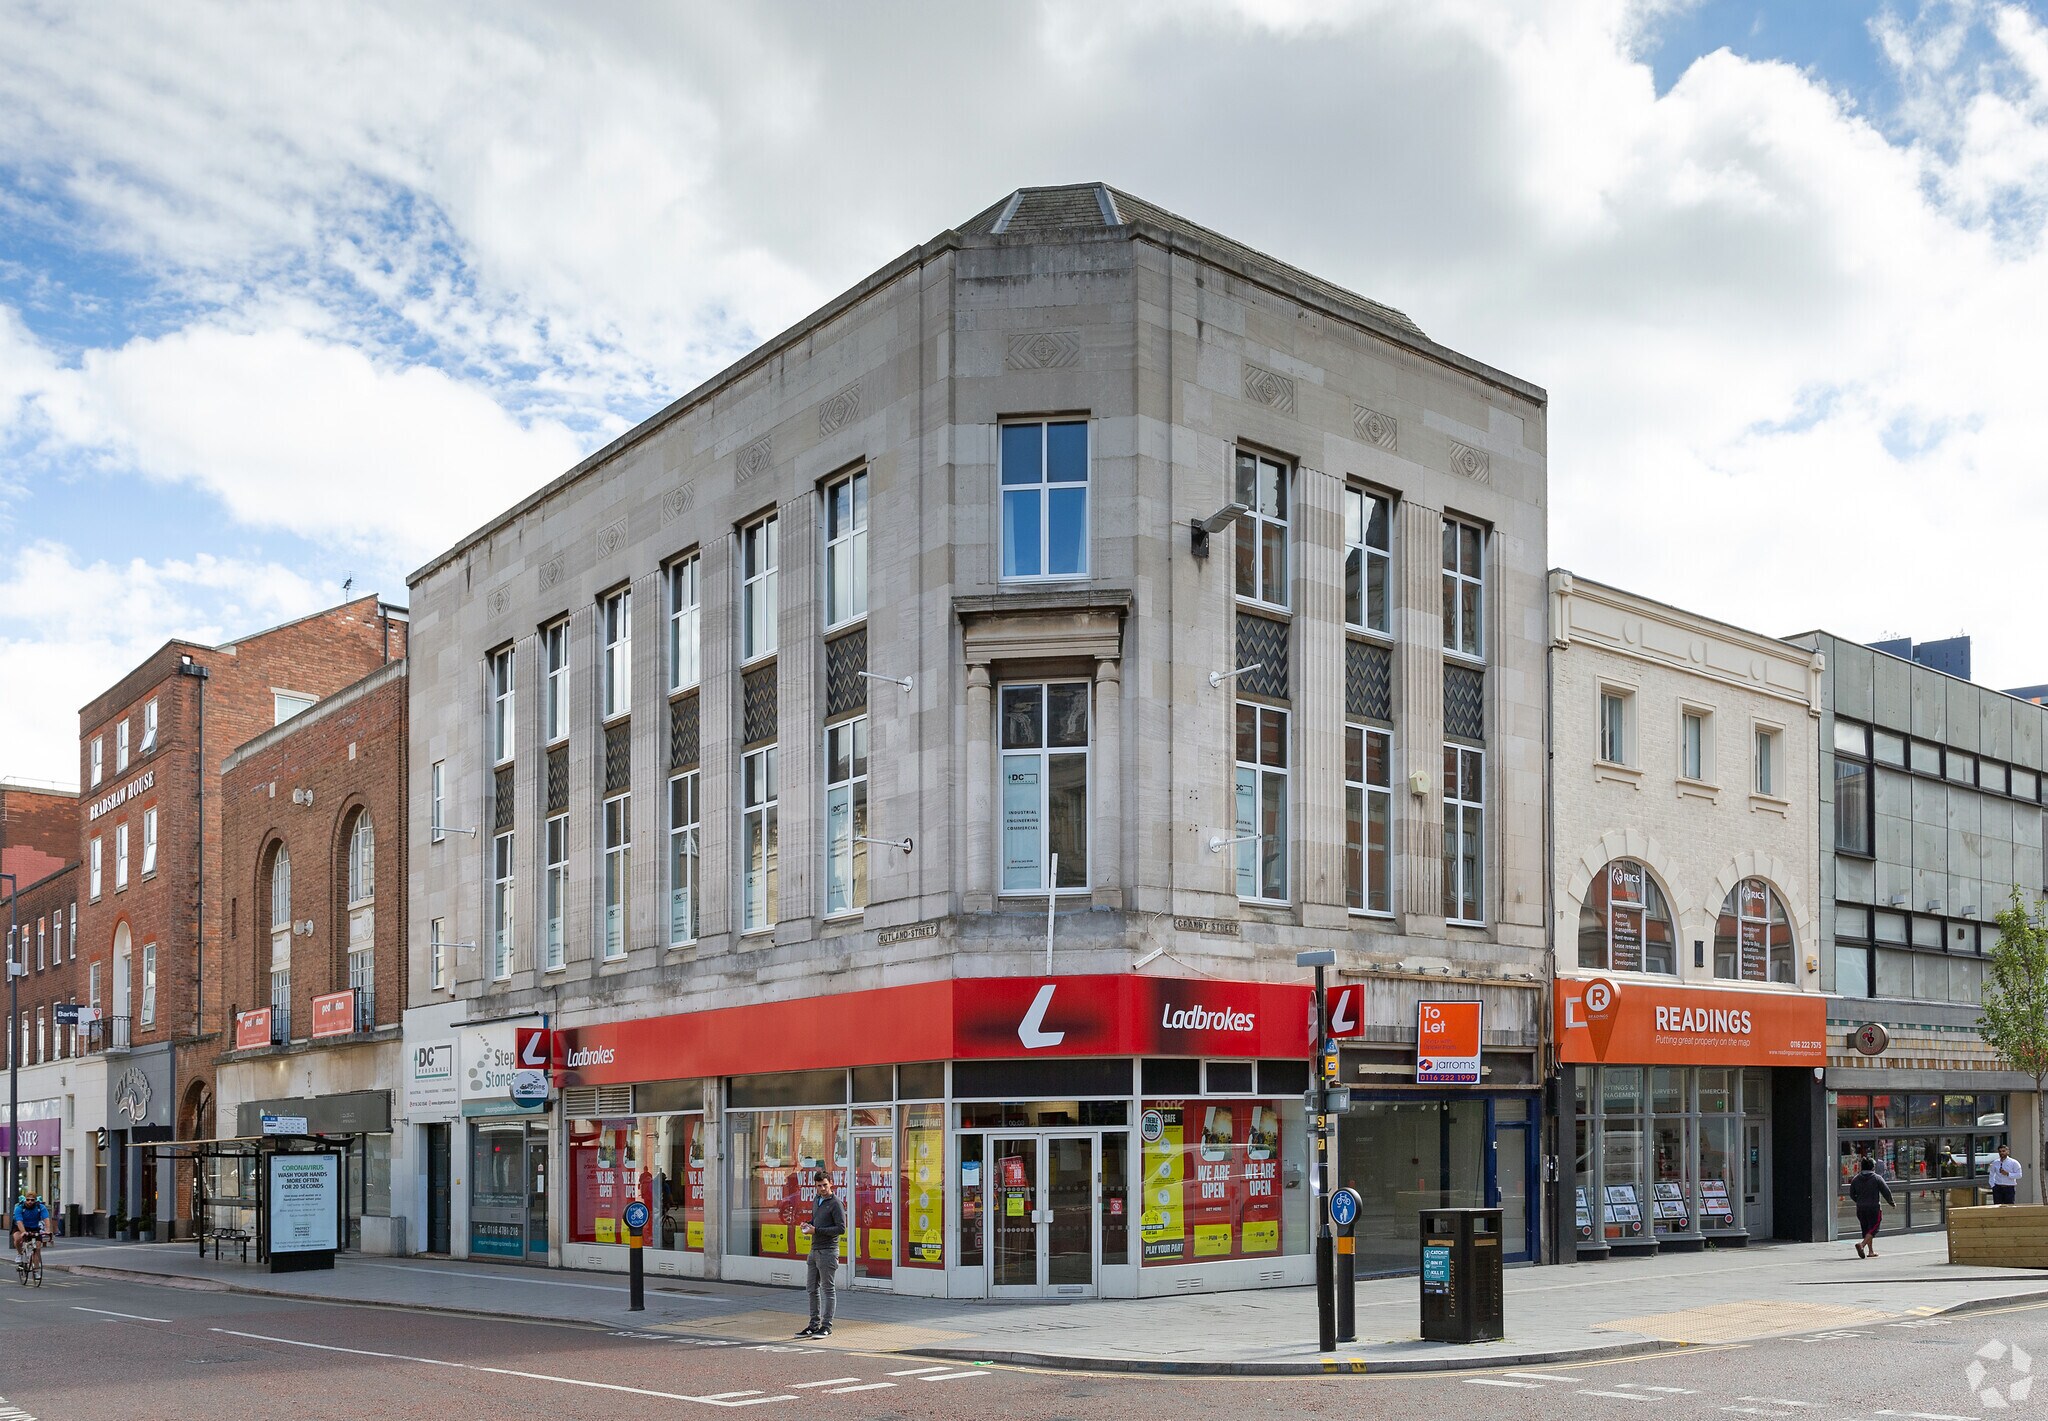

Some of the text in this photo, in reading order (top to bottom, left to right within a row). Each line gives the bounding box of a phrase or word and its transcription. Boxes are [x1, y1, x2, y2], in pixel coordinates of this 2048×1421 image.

[90, 770, 154, 821] BRADSHAW HOUSE
[1624, 873, 1640, 883] RICS
[1752, 891, 1764, 900] RICS
[880, 926, 934, 942] RUTLAND STREET
[1212, 923, 1237, 932] STREET
[1592, 989, 1605, 1005] R
[1162, 1003, 1255, 1032] Ladbrokes
[1424, 1006, 1440, 1018] To
[1424, 1021, 1445, 1033] Let
[1656, 1006, 1752, 1034] READINGS
[1656, 1035, 1676, 1045] Putting
[1678, 1037, 1694, 1045] great
[1694, 1037, 1720, 1047] property
[419, 1047, 434, 1067] DC
[567, 1045, 614, 1067] Ladbrokes
[1435, 1059, 1475, 1071] jarroms
[1164, 1114, 1176, 1122] SAFE
[18, 1126, 38, 1150] Scope
[596, 1172, 615, 1184] WE ARE
[622, 1172, 631, 1184] WE
[688, 1171, 696, 1184] WE
[763, 1171, 786, 1185] WE ARE
[796, 1171, 807, 1185] WE
[833, 1171, 844, 1185] WE
[1198, 1165, 1230, 1181] WE ARE
[1245, 1163, 1275, 1179] WE ARE
[871, 1171, 884, 1186] WE
[600, 1185, 612, 1198] OPEN
[767, 1187, 782, 1200] OPEN
[1202, 1182, 1224, 1198] OPEN
[1250, 1180, 1271, 1196] OPEN
[1146, 1244, 1184, 1254] PLAY YOUR PART
